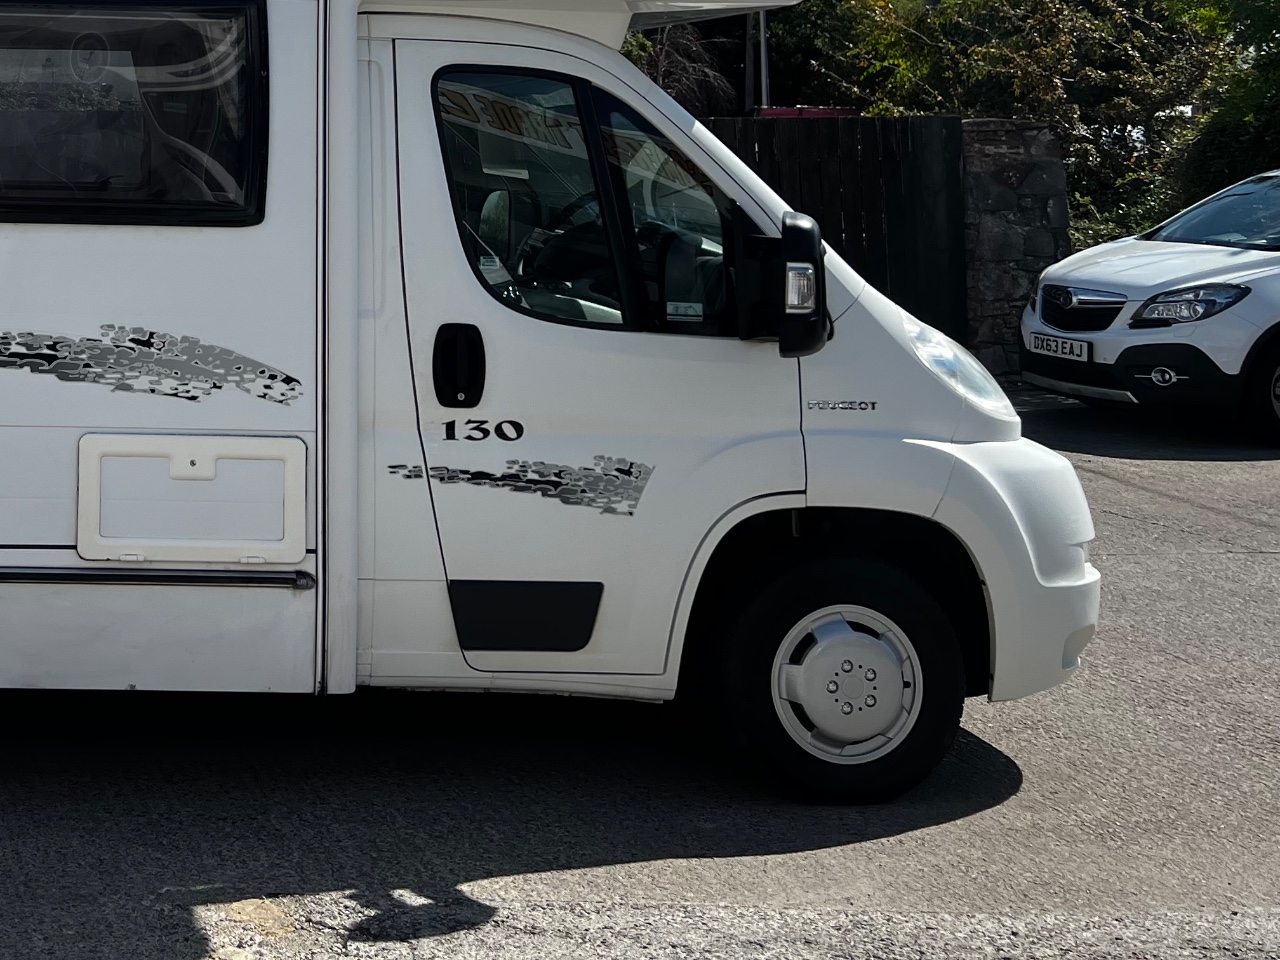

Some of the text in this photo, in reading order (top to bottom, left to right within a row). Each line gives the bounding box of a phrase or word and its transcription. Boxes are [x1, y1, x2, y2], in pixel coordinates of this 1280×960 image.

[1033, 336, 1083, 358] DX63 EAJ
[807, 400, 879, 411] PEUGEOT
[441, 419, 525, 442] 130
